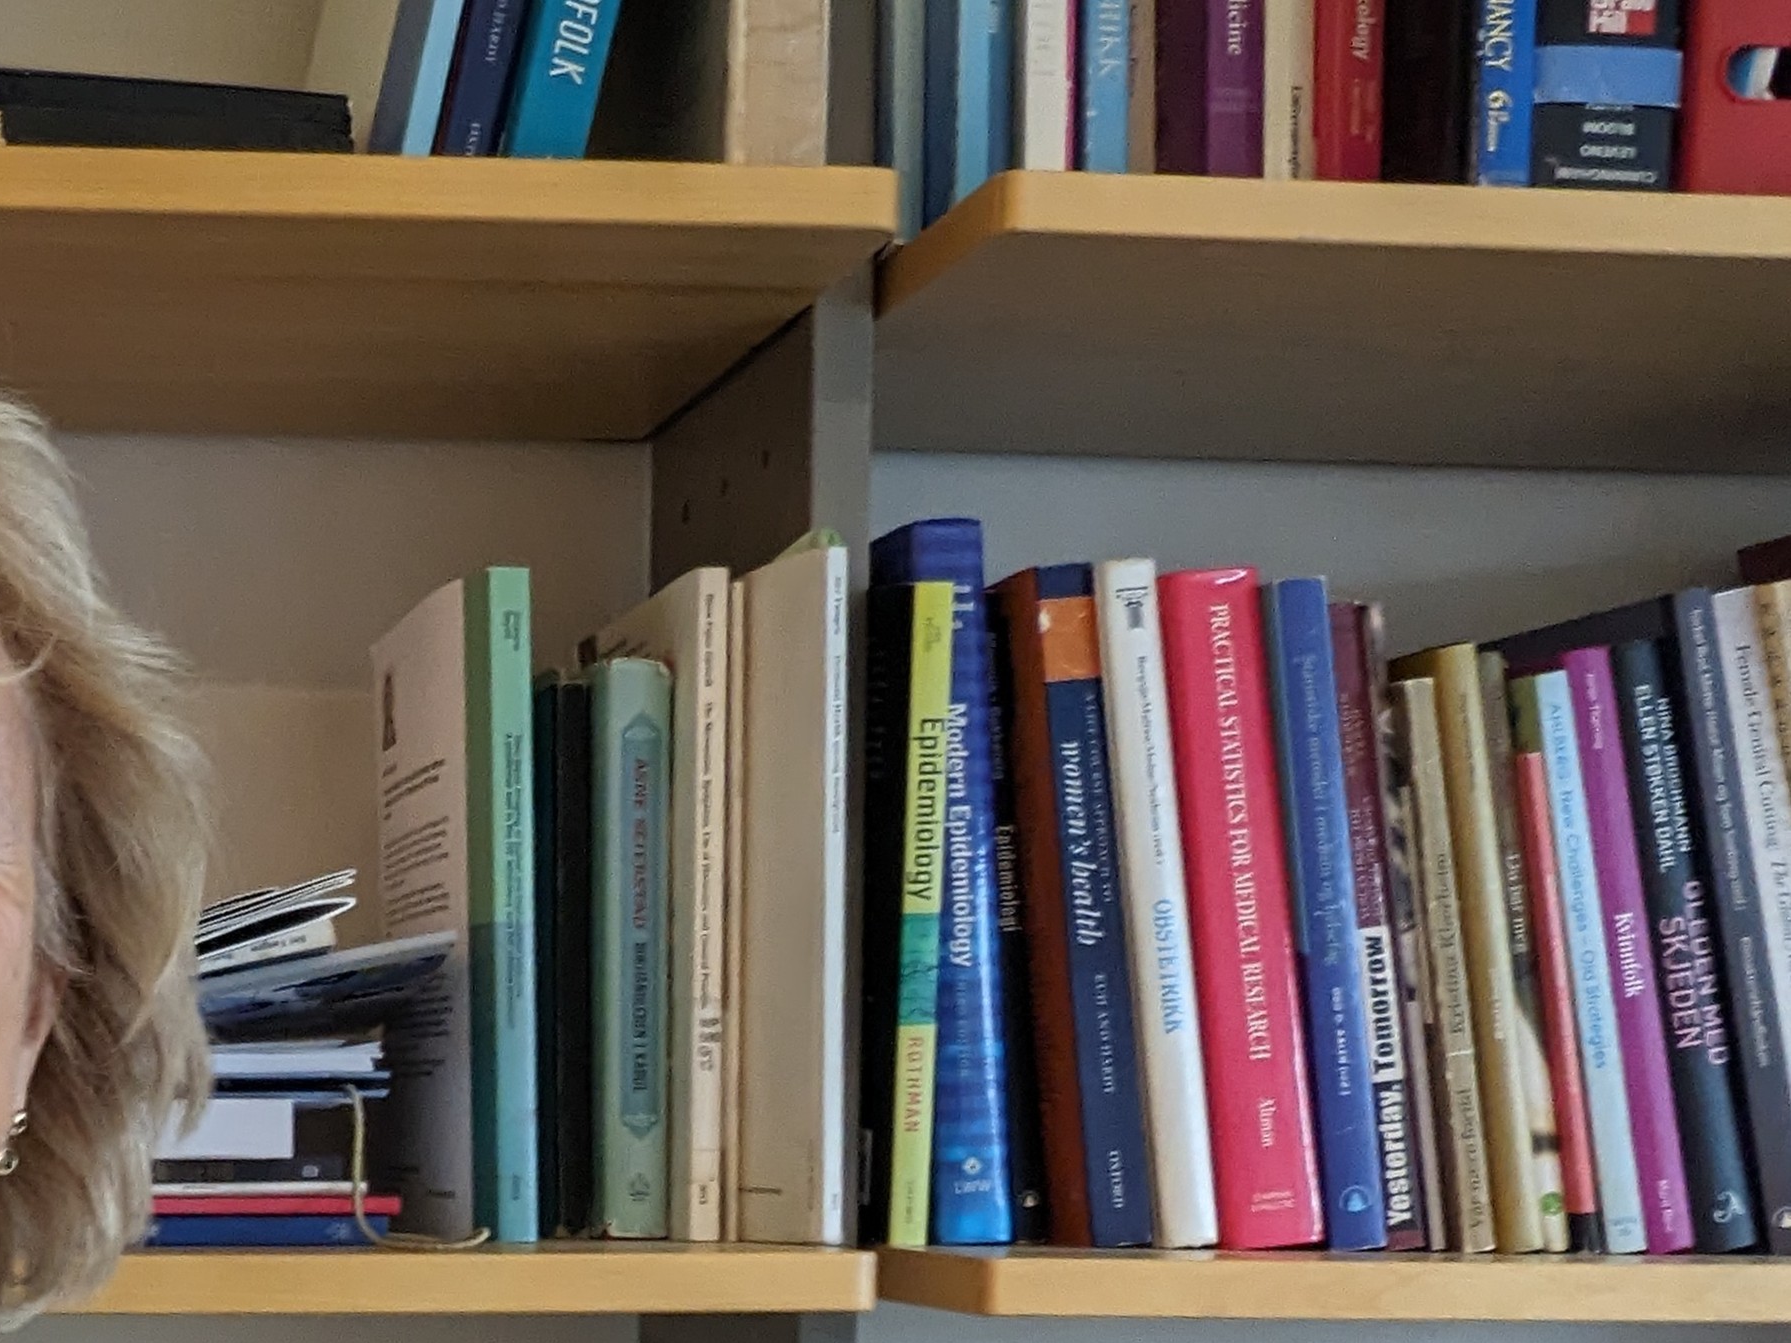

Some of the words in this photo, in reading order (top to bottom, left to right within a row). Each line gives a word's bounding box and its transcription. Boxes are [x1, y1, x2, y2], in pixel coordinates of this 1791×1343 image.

[549, 0, 602, 85] FOLK
[1210, 604, 1239, 710] PRACTICAL
[1734, 643, 1761, 707] Female
[946, 704, 969, 798] Modern
[1634, 684, 1659, 746] ELLEN
[907, 717, 946, 901] Epidemiology
[1219, 716, 1250, 822] STATISTICS
[1559, 790, 1578, 828] New
[945, 805, 976, 968] Epidemiology
[1229, 823, 1254, 871] FOR
[1562, 832, 1593, 933] Challenges
[1071, 856, 1104, 946] health
[1232, 872, 1262, 958] MEDICAL
[1152, 899, 1187, 1035] OBSTETRIKK
[1614, 912, 1645, 999] Kvinnfolk
[1660, 916, 1703, 1050] SKJEDEN
[1240, 960, 1272, 1061] RESEARCH
[1365, 935, 1396, 1075] Tomorrow
[1581, 984, 1611, 1070] Strategies
[1701, 998, 1729, 1066] MED
[906, 1036, 924, 1133] ROTHMAN
[1106, 1150, 1124, 1209] OXFORD
[1379, 1083, 1412, 1225] Yesterday,
